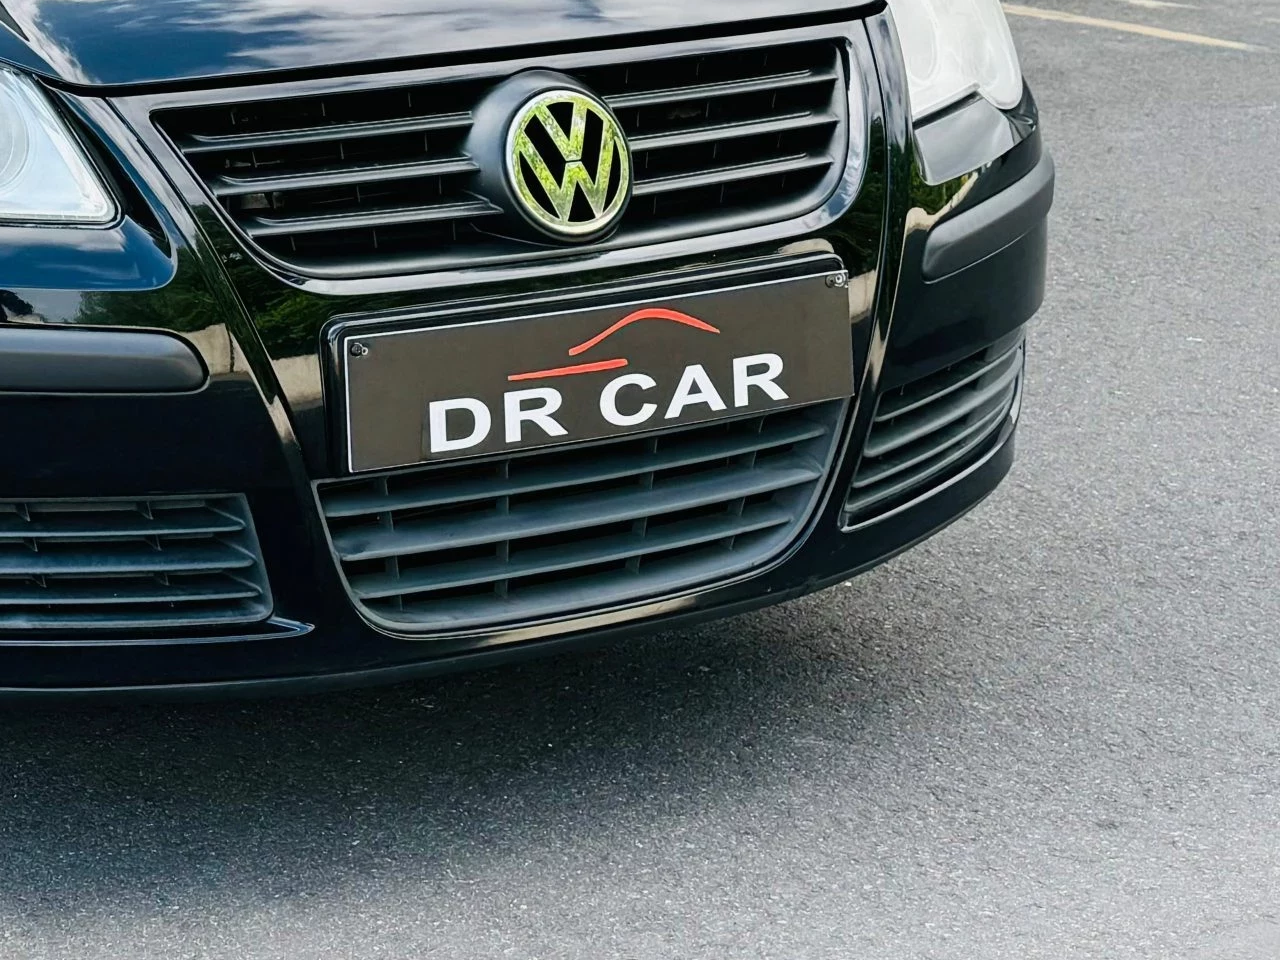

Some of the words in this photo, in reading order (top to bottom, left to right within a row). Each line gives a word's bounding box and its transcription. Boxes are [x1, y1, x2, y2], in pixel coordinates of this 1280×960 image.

[512, 95, 623, 228] VW
[428, 386, 569, 454] DR
[598, 352, 790, 427] CAR
